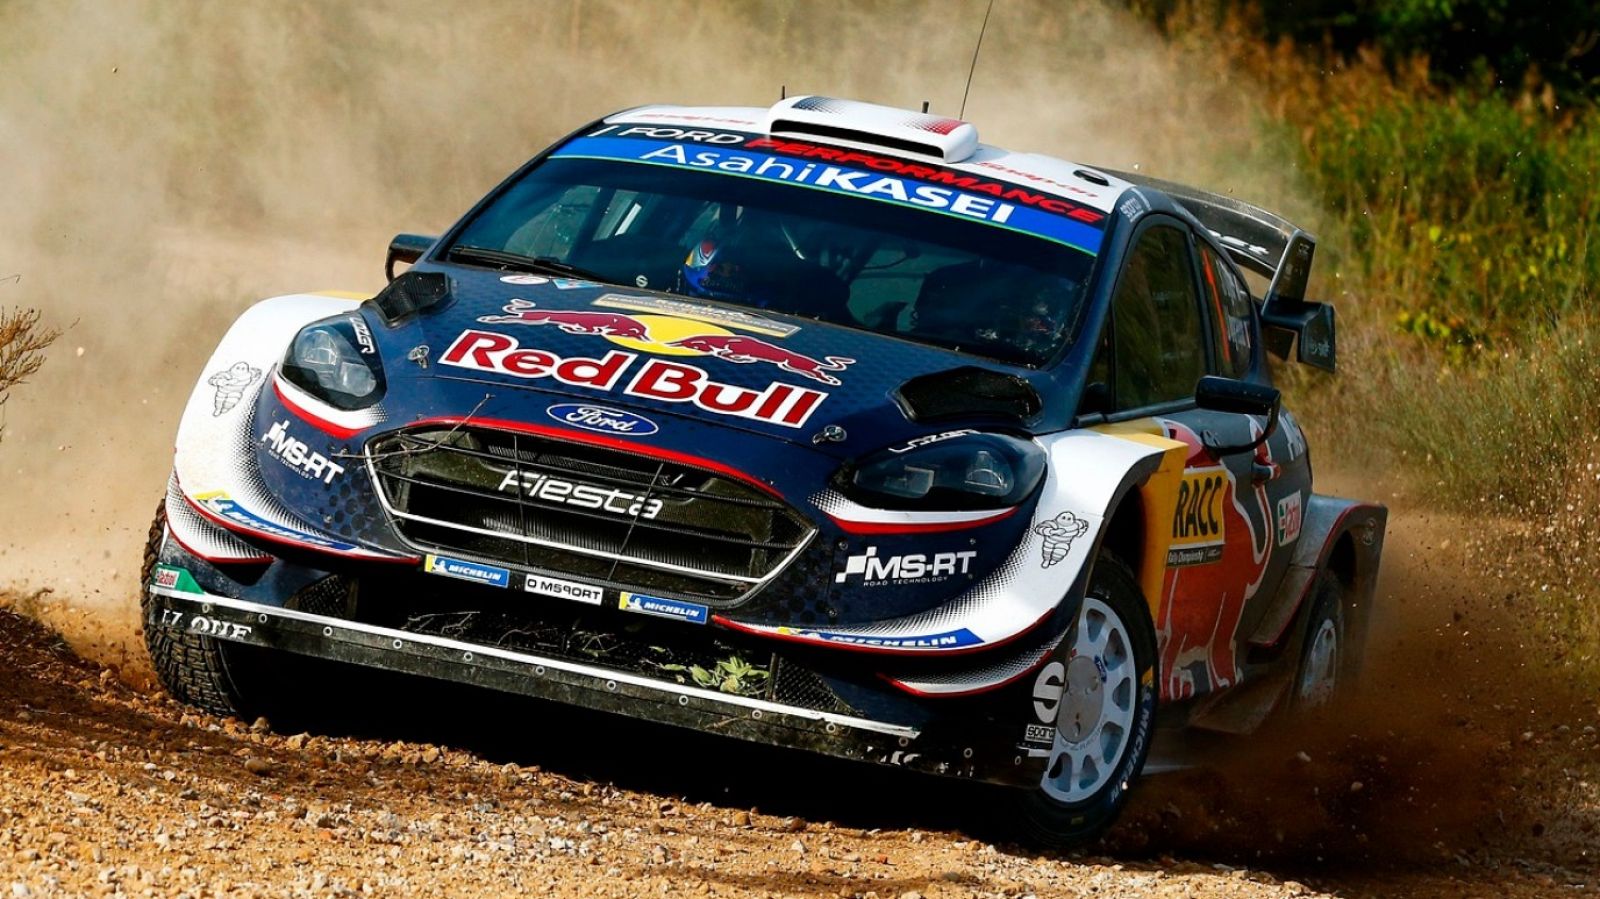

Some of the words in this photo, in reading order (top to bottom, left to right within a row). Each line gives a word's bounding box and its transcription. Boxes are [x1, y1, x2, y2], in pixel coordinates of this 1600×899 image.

[617, 127, 745, 145] FORD
[744, 138, 1104, 223] PERFORMANCE
[442, 331, 633, 389] Red
[627, 361, 824, 427] Bull
[566, 407, 639, 432] Ford
[1172, 476, 1223, 538] RACC
[448, 564, 502, 581] MICHELIN
[893, 576, 948, 585] TECHNOLOGY
[643, 601, 700, 617] MICHELIN
[828, 635, 957, 648] MICHELIN
